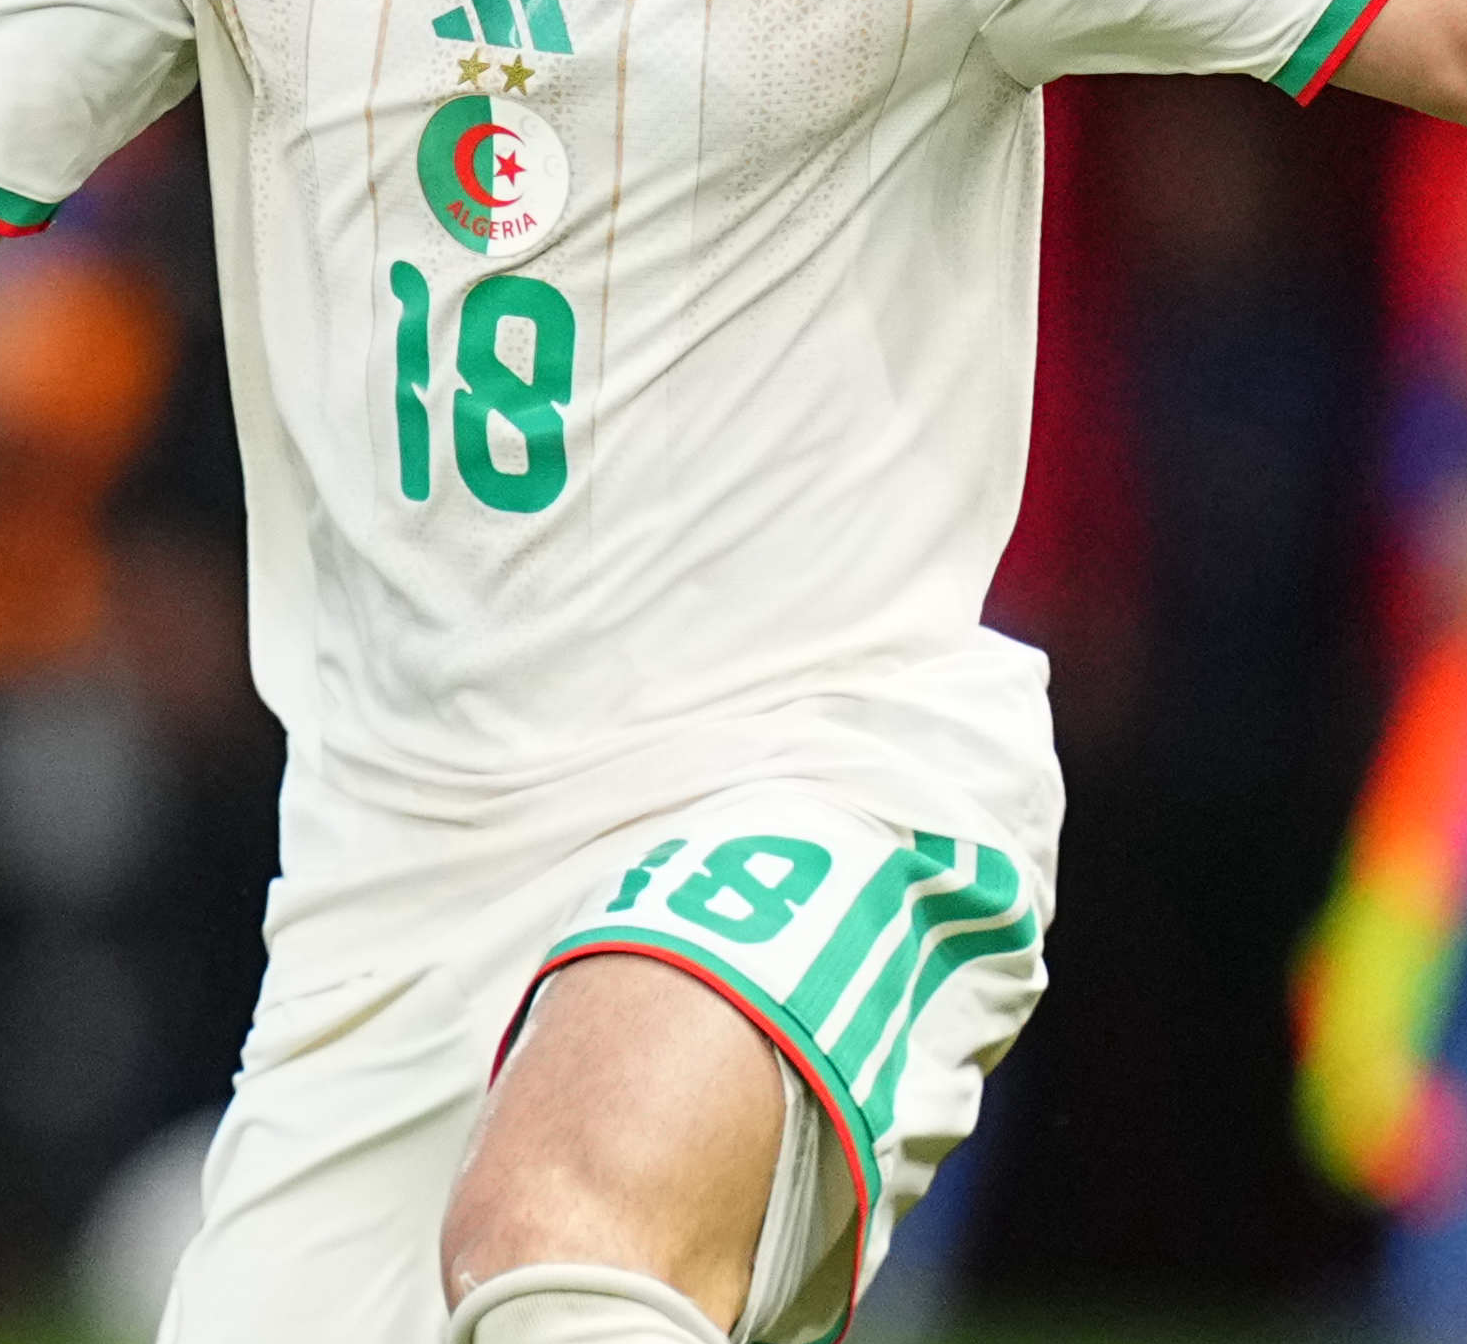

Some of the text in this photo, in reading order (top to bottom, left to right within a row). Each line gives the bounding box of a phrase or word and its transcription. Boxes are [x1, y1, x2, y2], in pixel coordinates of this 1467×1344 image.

[447, 199, 538, 241] ALGERIA
[390, 259, 576, 513] 18
[605, 834, 833, 945] 18
